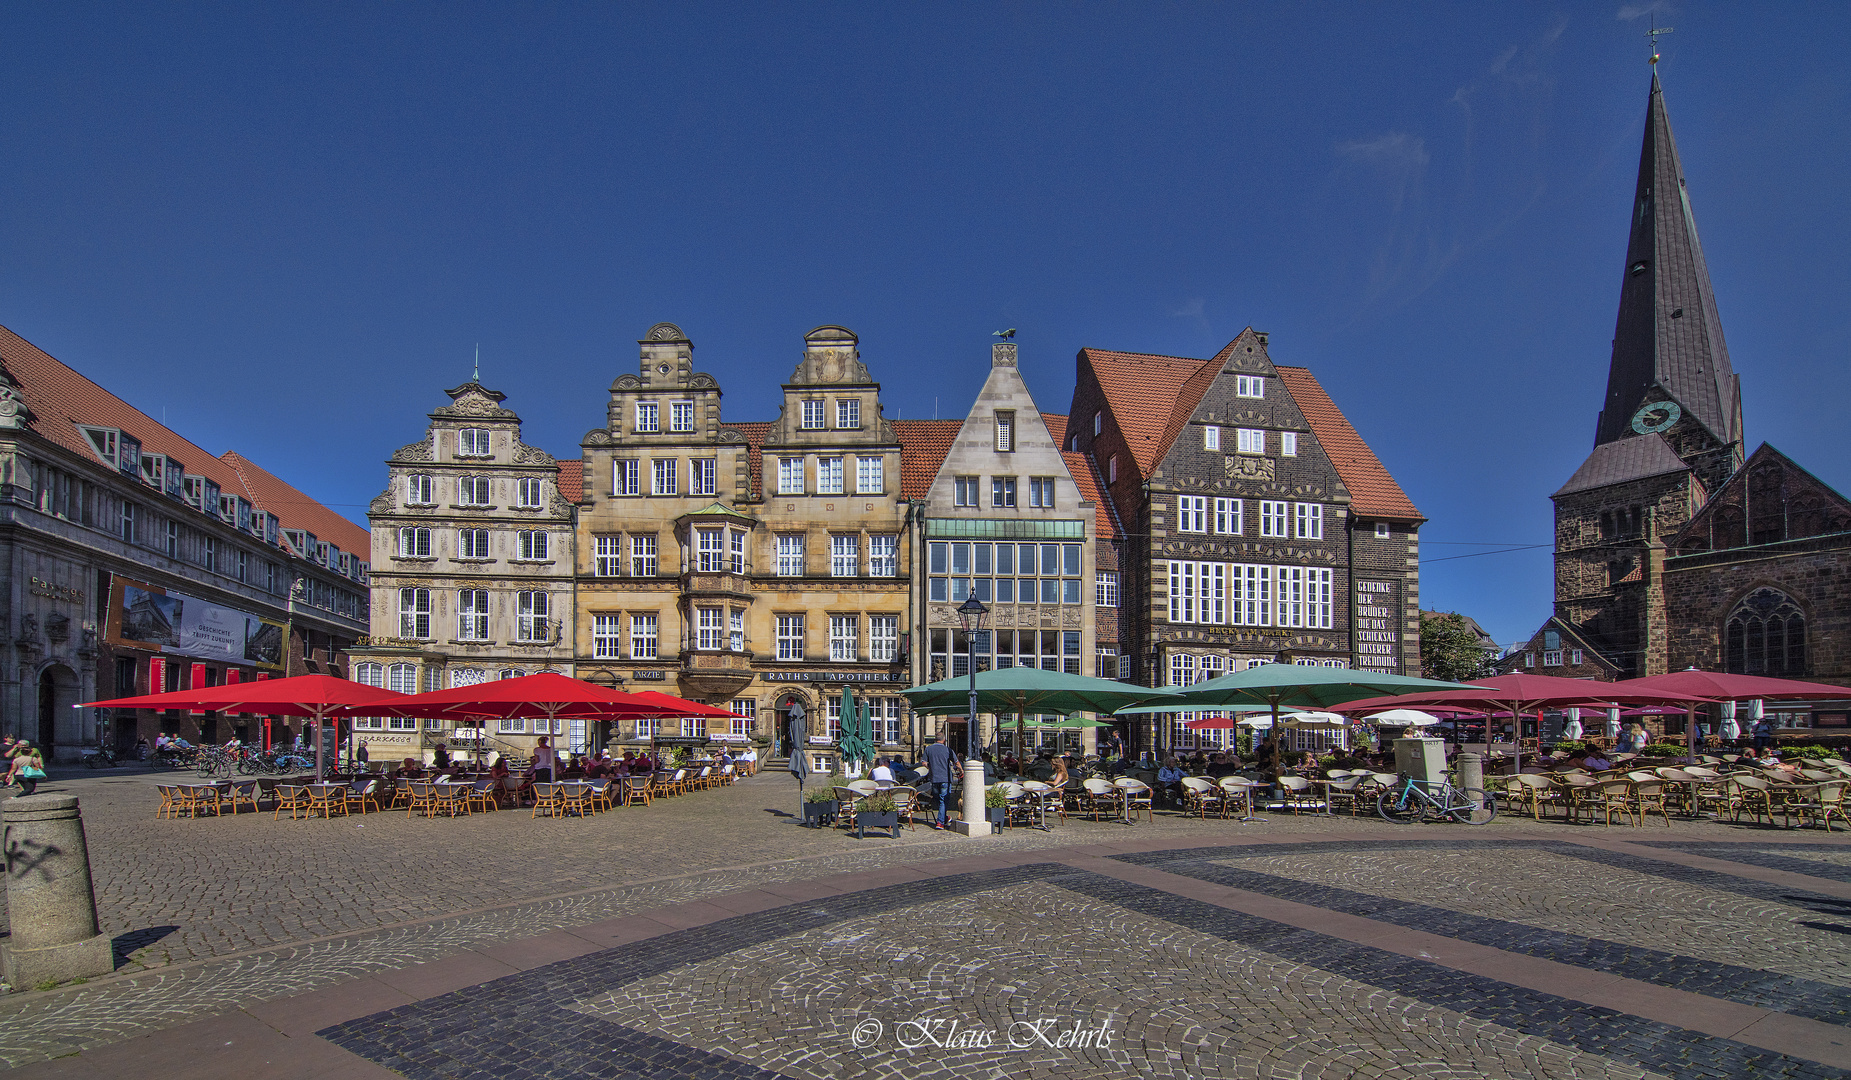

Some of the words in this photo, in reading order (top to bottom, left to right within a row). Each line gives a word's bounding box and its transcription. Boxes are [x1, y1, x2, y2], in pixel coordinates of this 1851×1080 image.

[1358, 582, 1390, 593] GEDENKE
[1358, 594, 1373, 604] DER
[1358, 605, 1391, 619] BRÜDER,
[1358, 619, 1370, 629] DIE
[1371, 620, 1386, 630] DAS
[198, 624, 231, 637] GESCHICHTE
[1260, 629, 1295, 637] MARKT
[211, 635, 235, 645] ZUKUNFT
[356, 636, 420, 647] SPARKASSE
[1358, 631, 1396, 642] SCHICKSAL
[1358, 643, 1392, 654] UNSERER
[1359, 656, 1397, 667] TRENNUNG
[768, 672, 810, 681] RATHS
[829, 672, 899, 681] APOTHEKE
